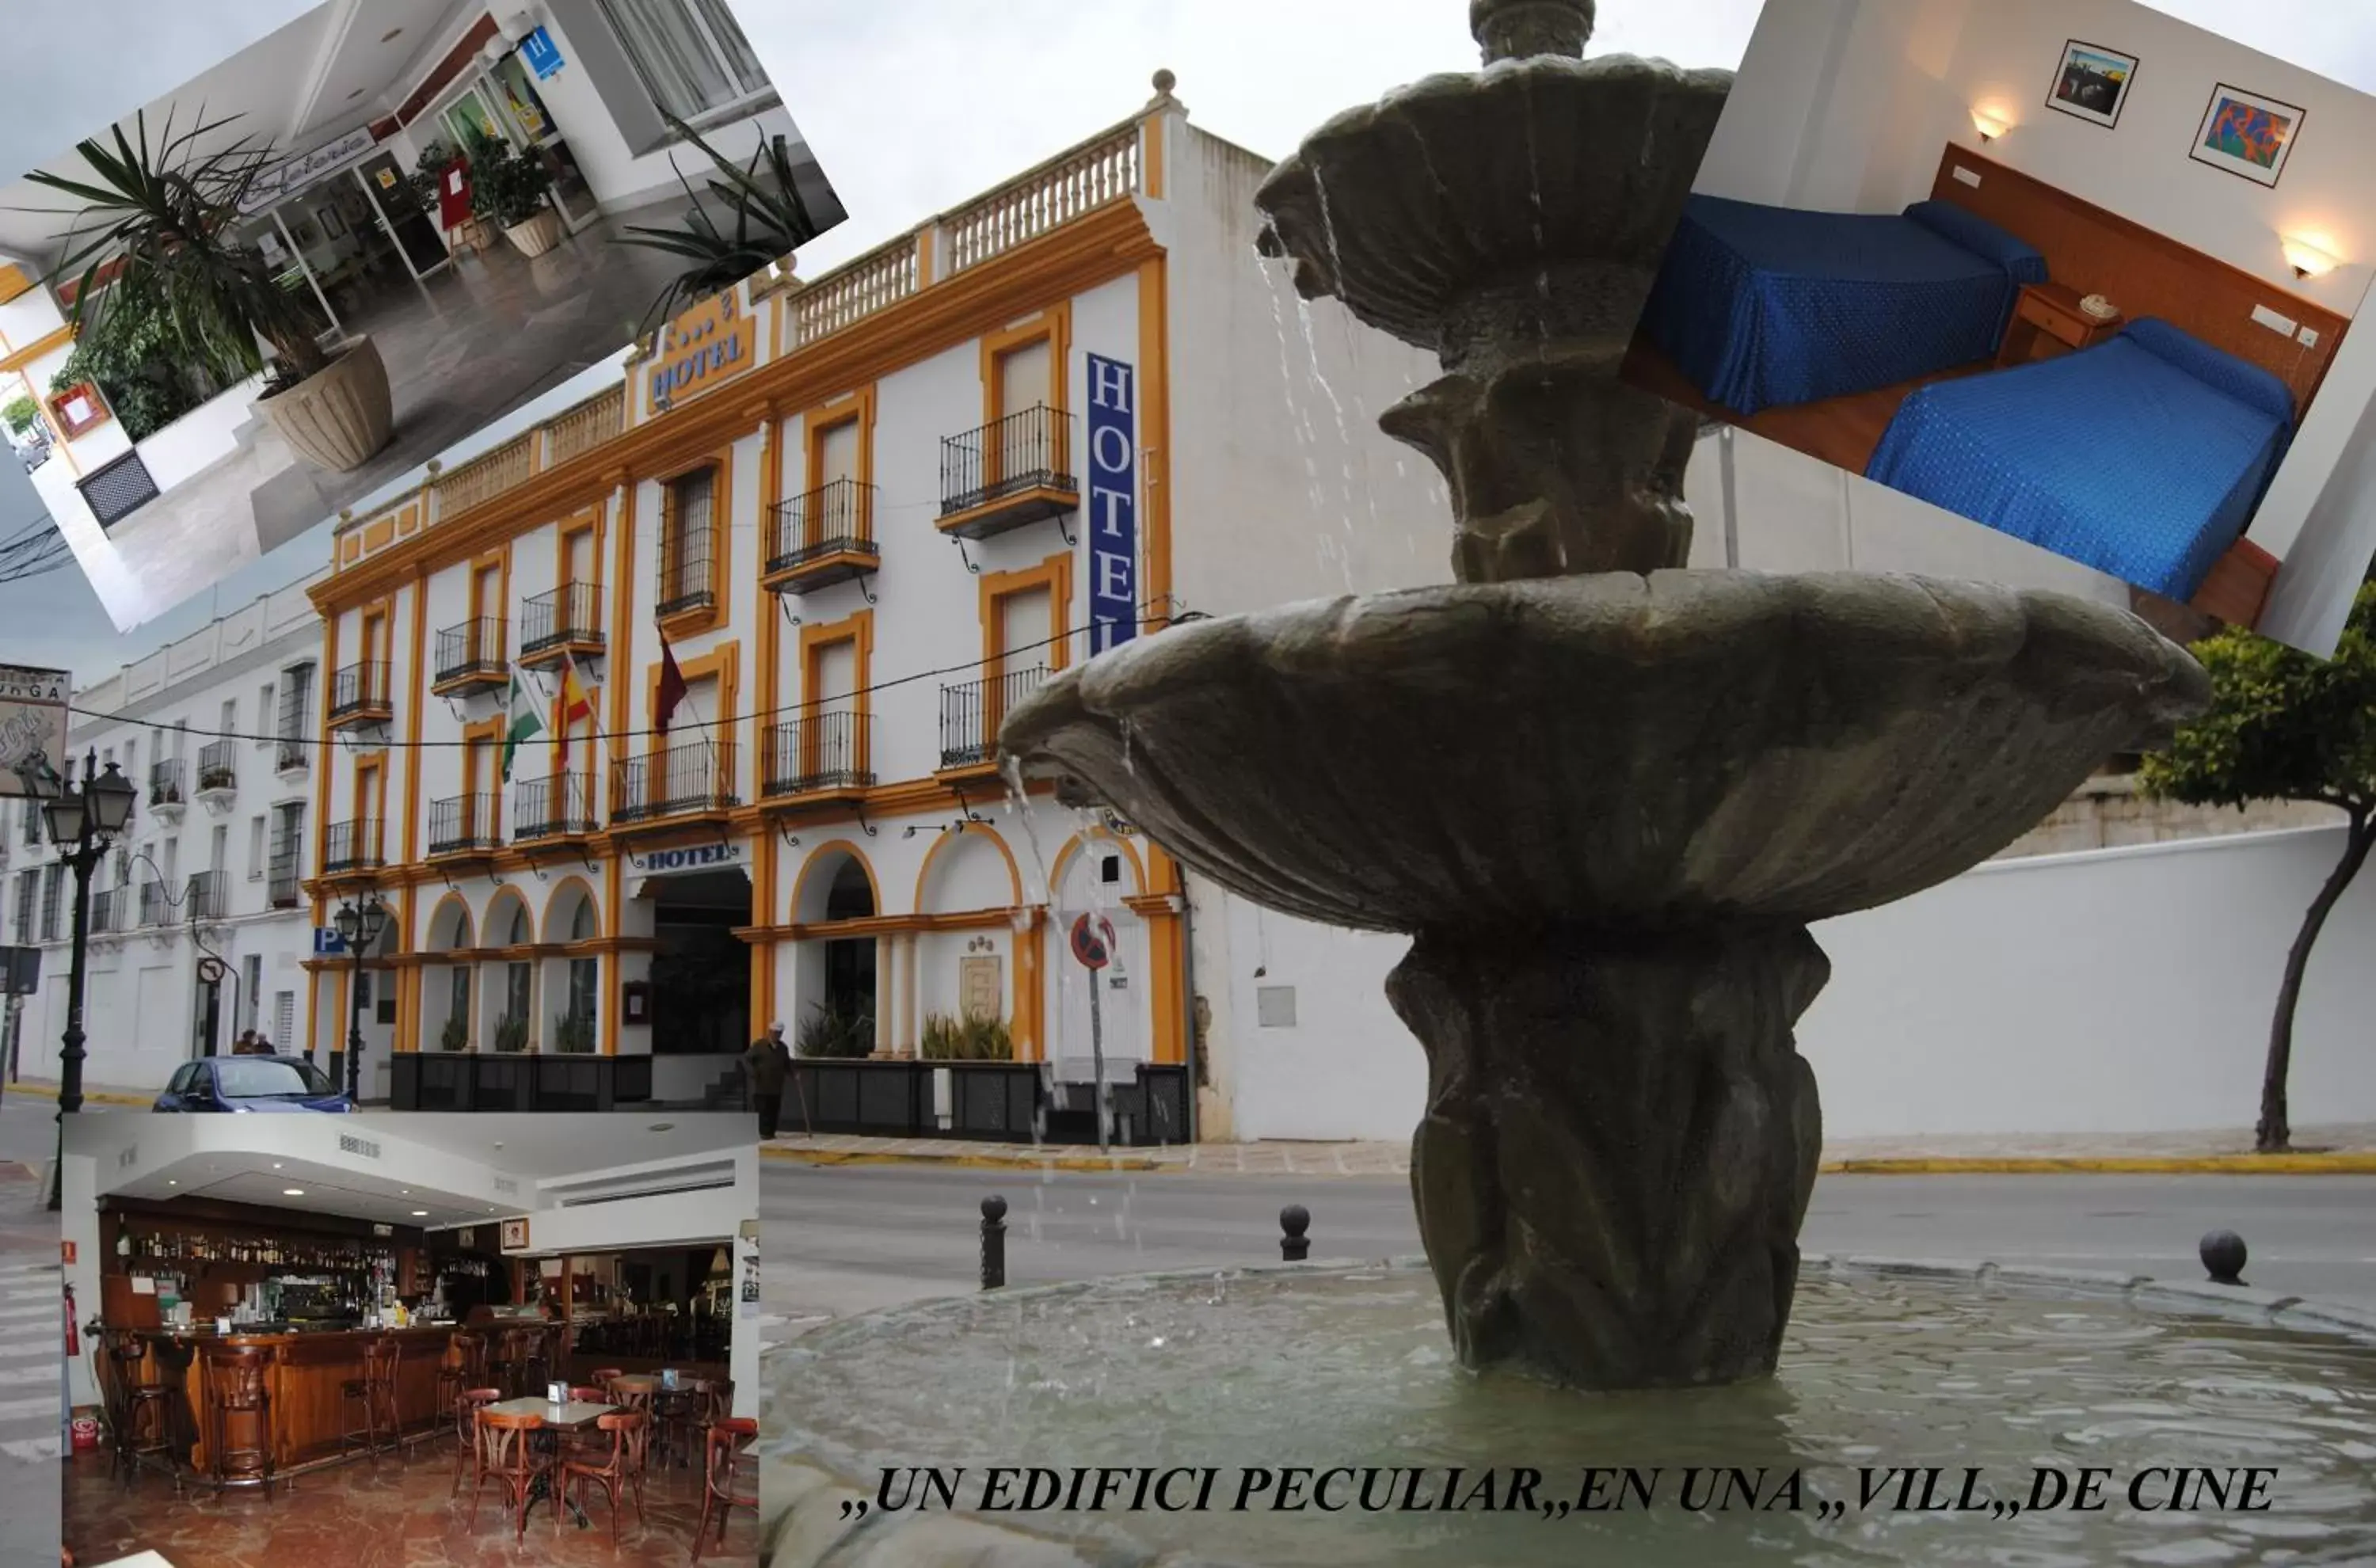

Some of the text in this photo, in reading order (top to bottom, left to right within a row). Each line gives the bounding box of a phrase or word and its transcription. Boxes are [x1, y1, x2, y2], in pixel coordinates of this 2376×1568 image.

[653, 331, 744, 399] HOTEL
[648, 843, 731, 870] HOTEL
[321, 929, 338, 951] P
